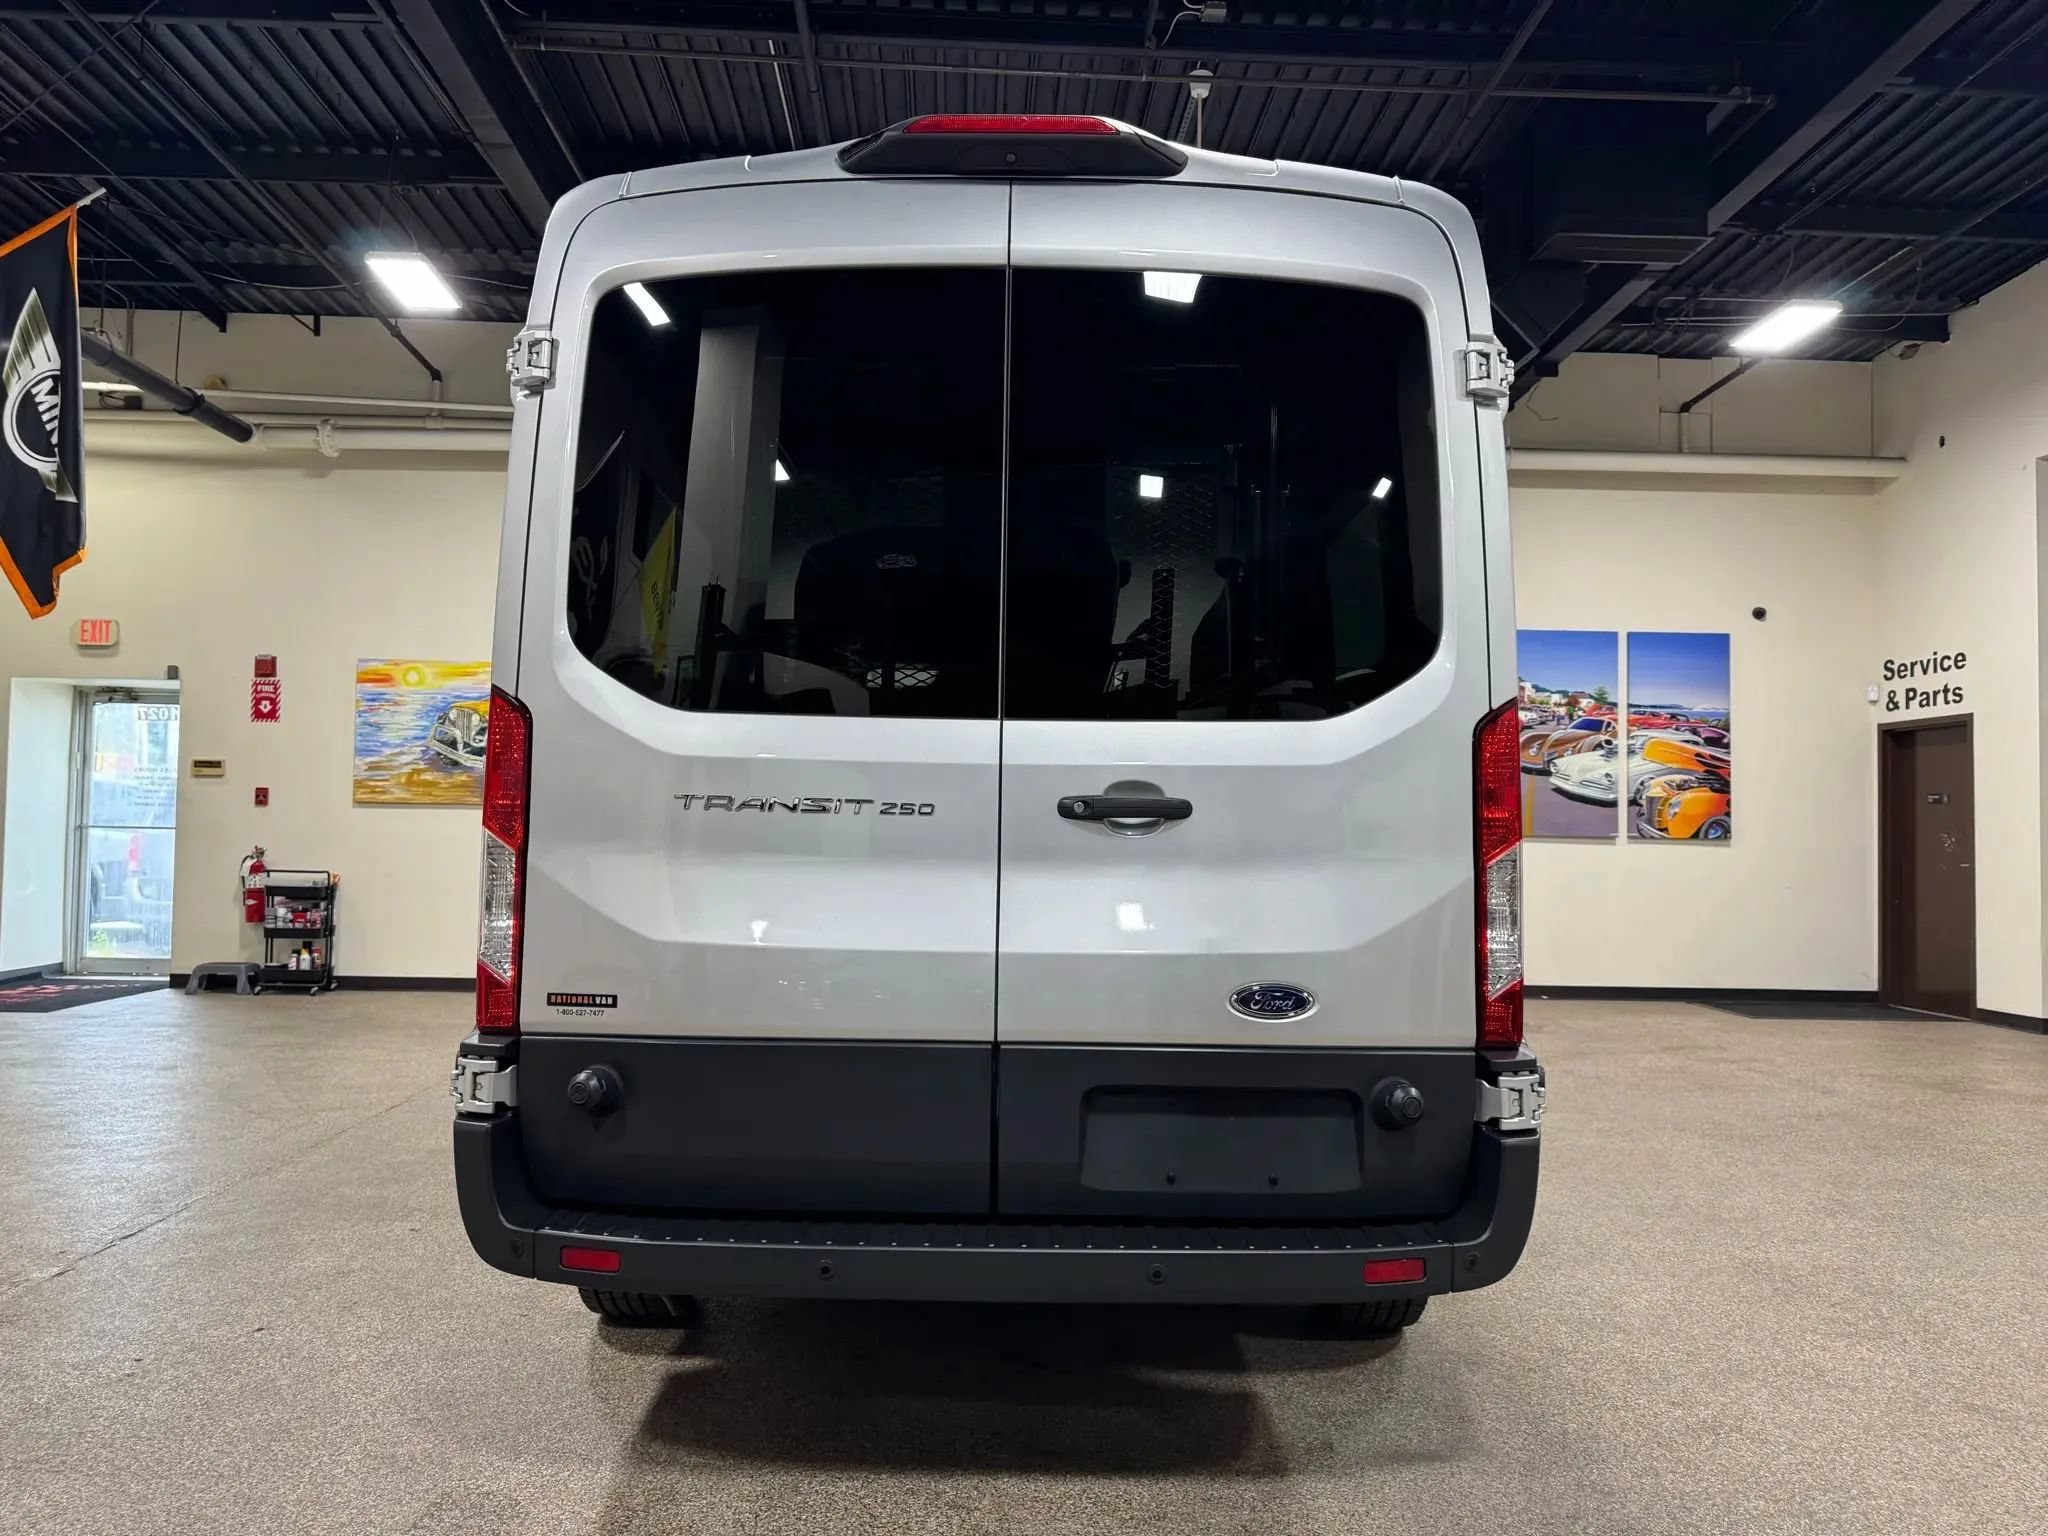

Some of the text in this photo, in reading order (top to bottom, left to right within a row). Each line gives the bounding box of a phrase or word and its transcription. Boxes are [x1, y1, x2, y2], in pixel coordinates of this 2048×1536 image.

[80, 619, 113, 643] EXIT
[1883, 650, 1967, 681] Service
[256, 684, 276, 693] FIRE
[1885, 682, 1964, 712] & Parts
[674, 793, 936, 816] TRANSIT 250
[550, 994, 613, 1005] NATIONAL VAN
[1249, 990, 1297, 1010] Ford
[555, 1008, 605, 1017] 1-800-527-7477
